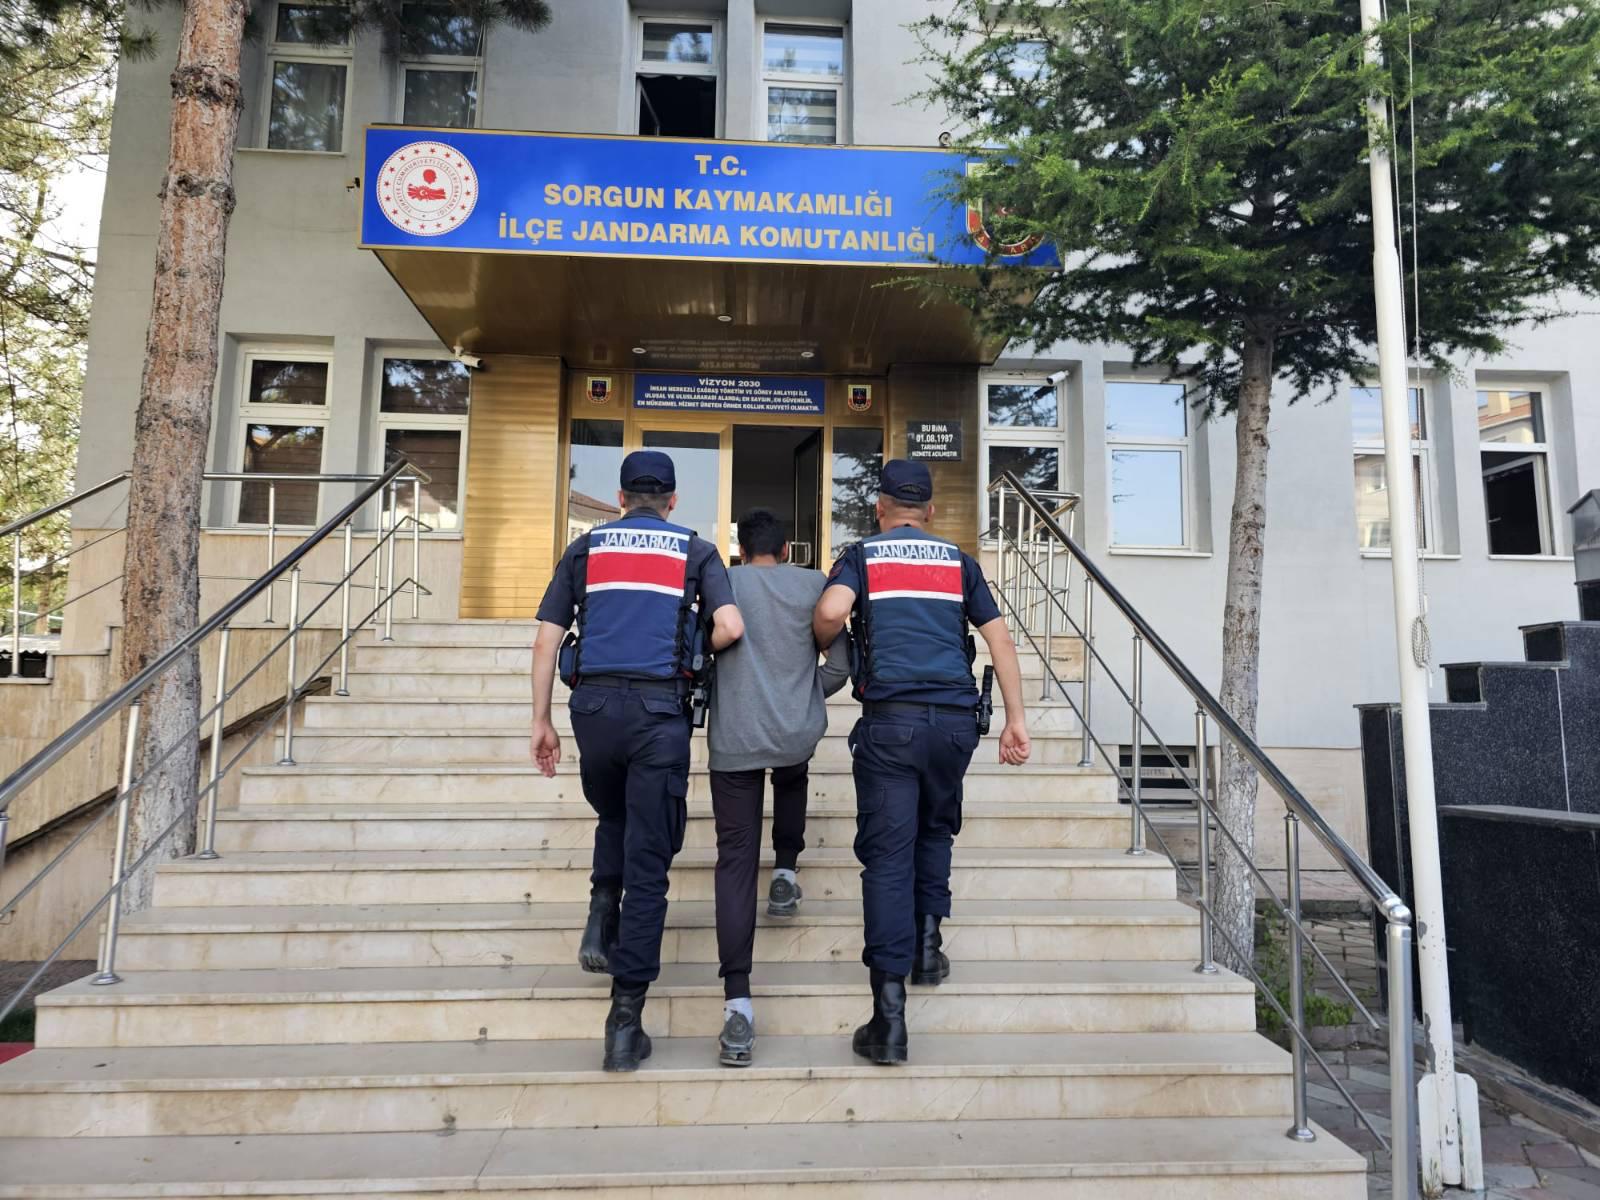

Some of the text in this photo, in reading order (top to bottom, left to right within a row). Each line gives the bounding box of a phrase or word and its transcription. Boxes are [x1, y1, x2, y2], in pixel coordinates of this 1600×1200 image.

[695, 154, 747, 179] T.C.
[545, 183, 892, 217] SORGUN KAYMAKAMLIĞI
[499, 212, 935, 254] İLÇE JANDARMA KOMUTANLIĞI
[699, 377, 761, 388] VİZYON 2030
[921, 424, 931, 433] BU
[600, 532, 681, 553] JANDARMA
[873, 544, 952, 561] JANDARMA
